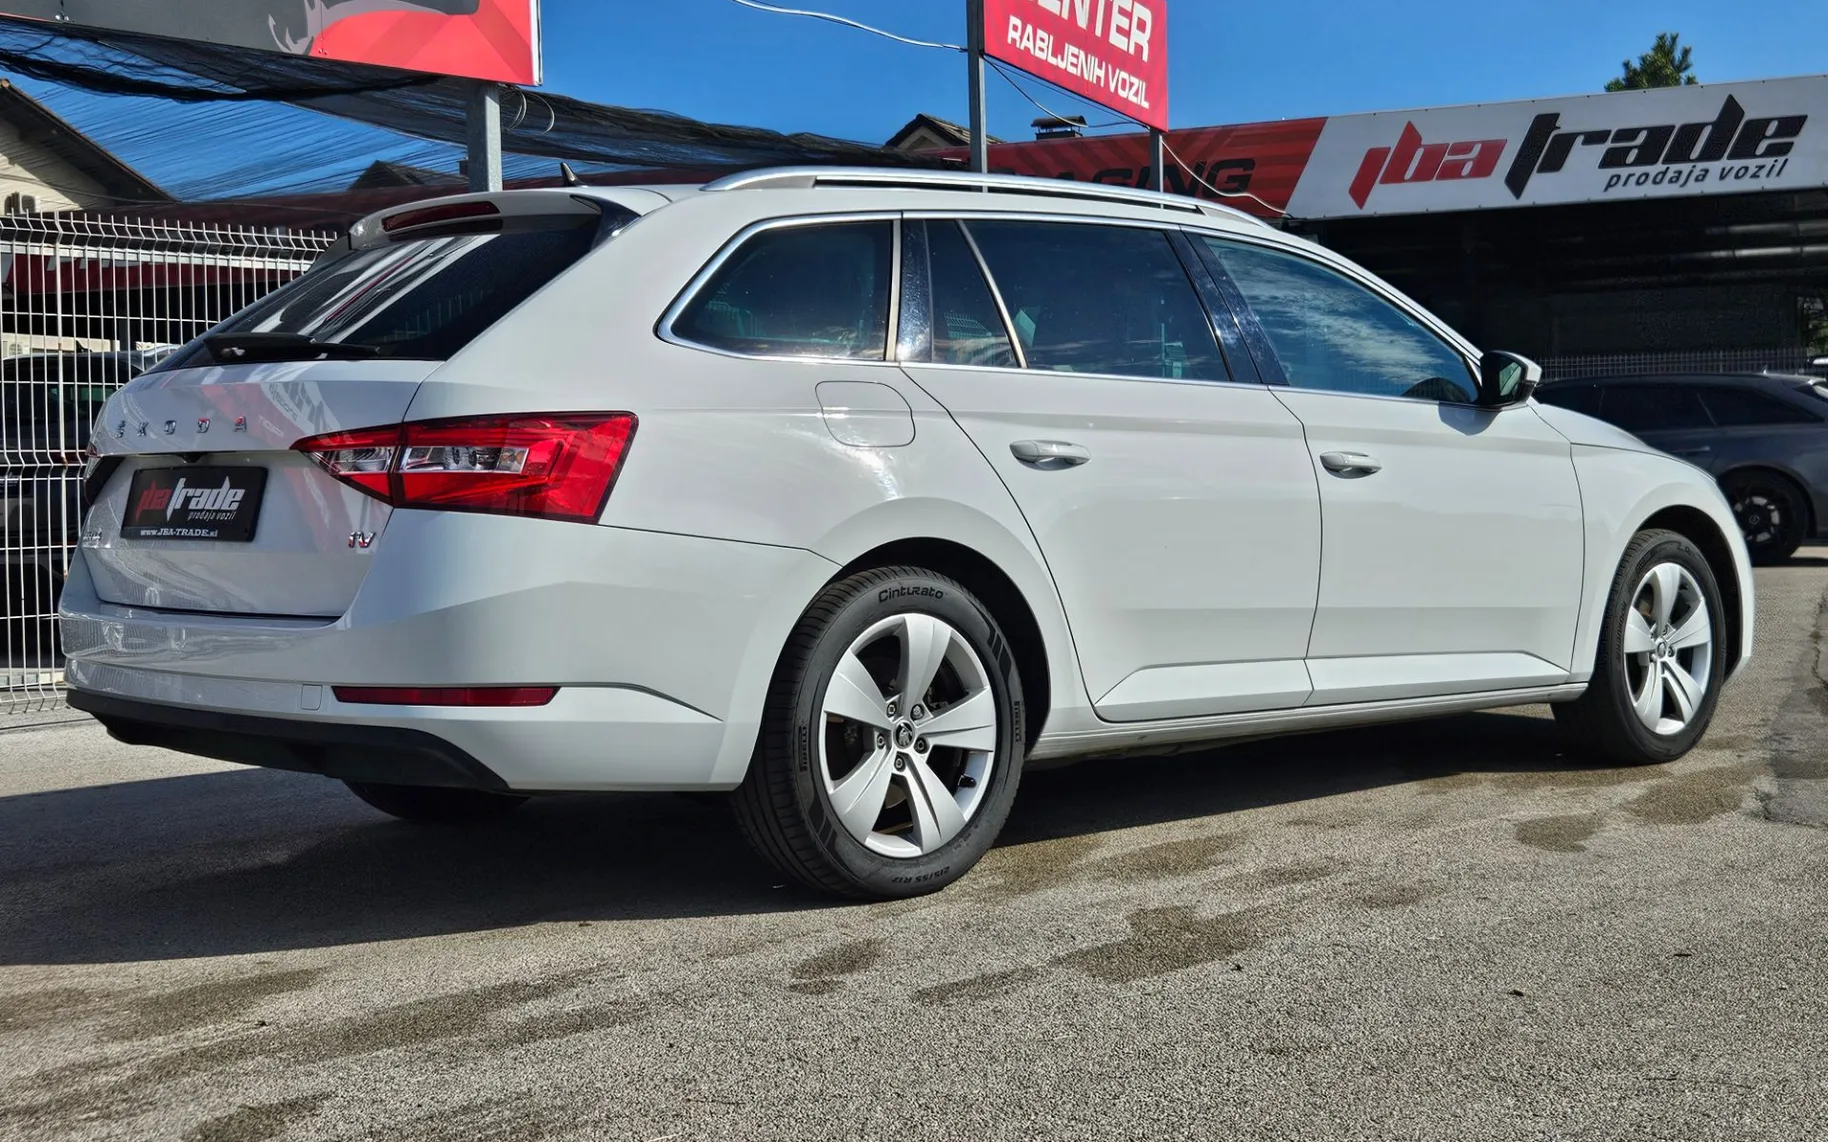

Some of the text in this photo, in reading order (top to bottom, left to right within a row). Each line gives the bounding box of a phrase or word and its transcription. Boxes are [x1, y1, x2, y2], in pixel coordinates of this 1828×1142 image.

[1030, 0, 1152, 63] NTER
[1007, 15, 1149, 109] RABLJENIH VOZIL
[1604, 158, 1789, 192] prodaja vozil
[187, 511, 236, 521] prodaja vozil
[878, 586, 944, 602] Cinturato
